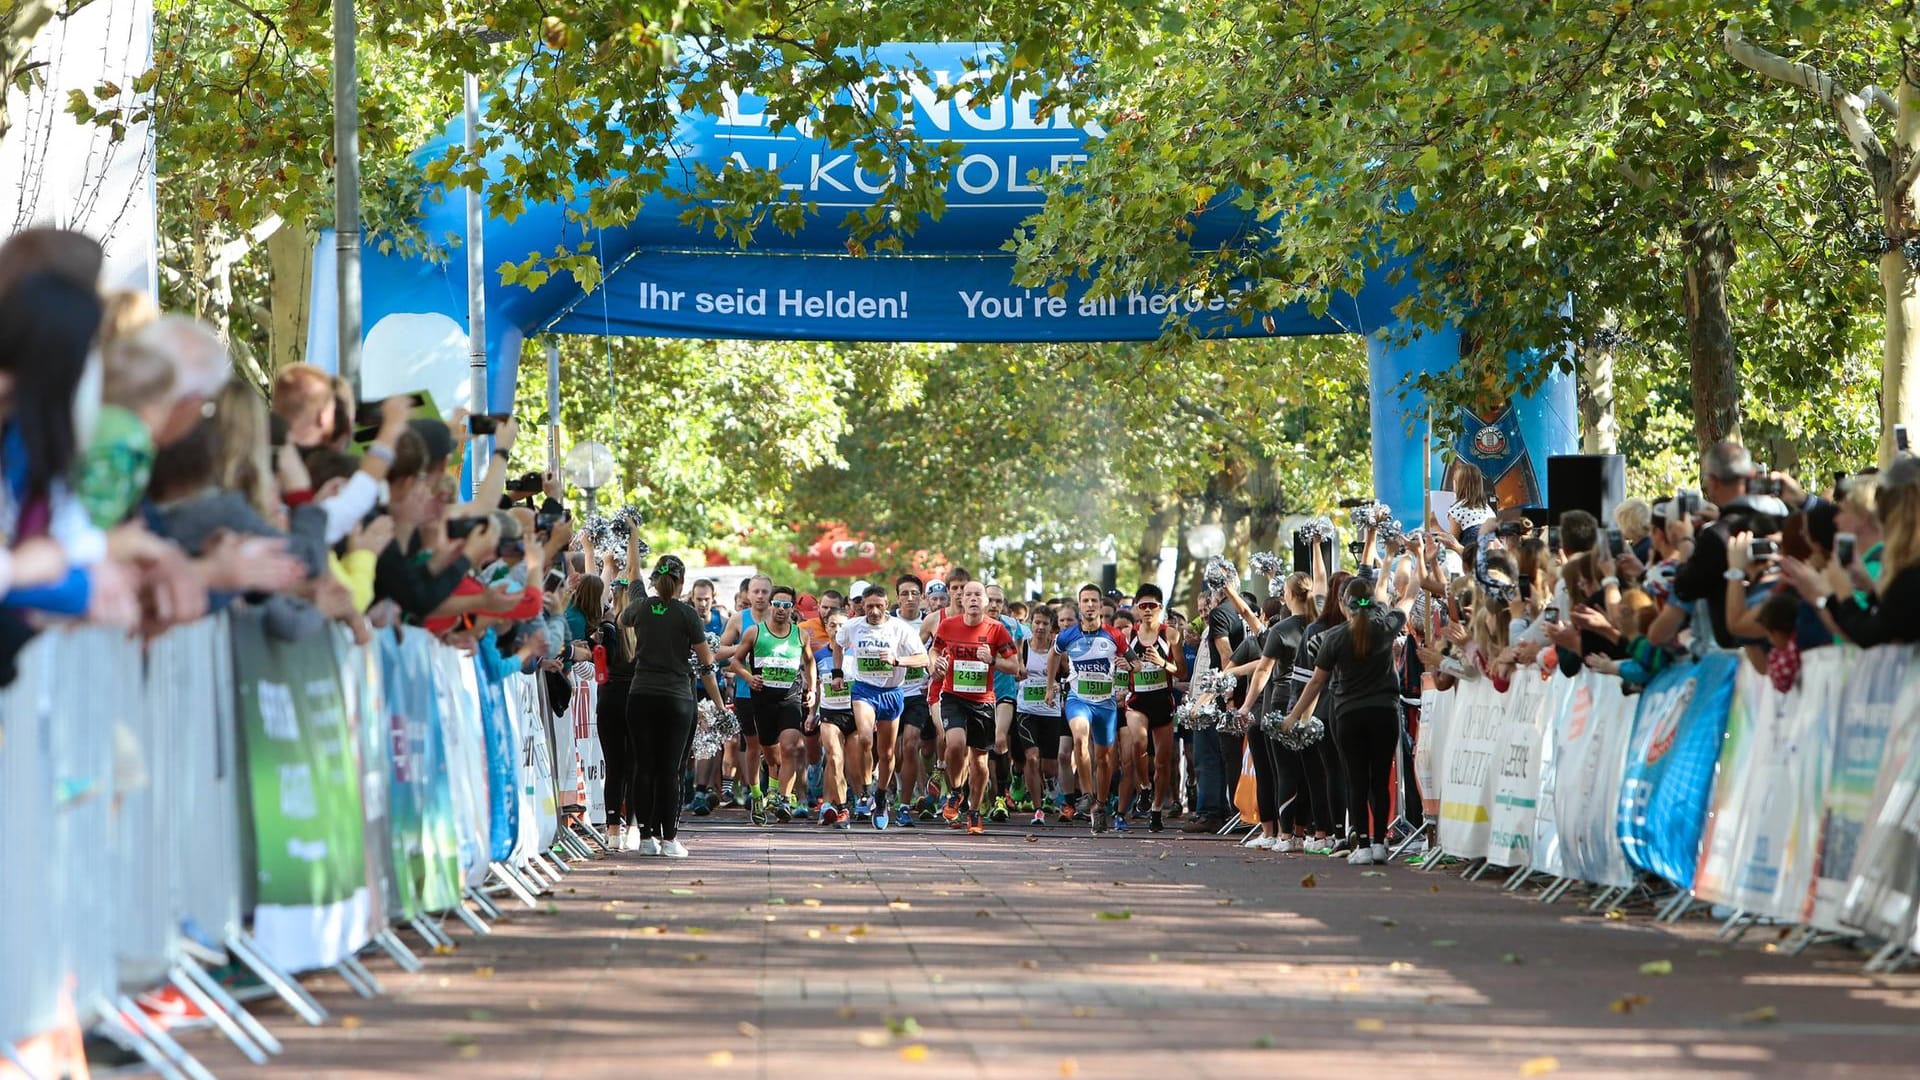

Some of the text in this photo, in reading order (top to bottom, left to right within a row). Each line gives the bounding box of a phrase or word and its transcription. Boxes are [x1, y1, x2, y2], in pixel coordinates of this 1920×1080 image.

[640, 282, 908, 318] Ihr seid Helden!
[958, 290, 1066, 318] You're
[1078, 290, 1116, 316] all
[858, 640, 890, 648] ITALIA
[1077, 663, 1106, 672] WERK
[959, 671, 983, 681] 2435
[1140, 671, 1159, 681] 1010
[1087, 681, 1104, 690] 1511
[1028, 687, 1048, 696] 243
